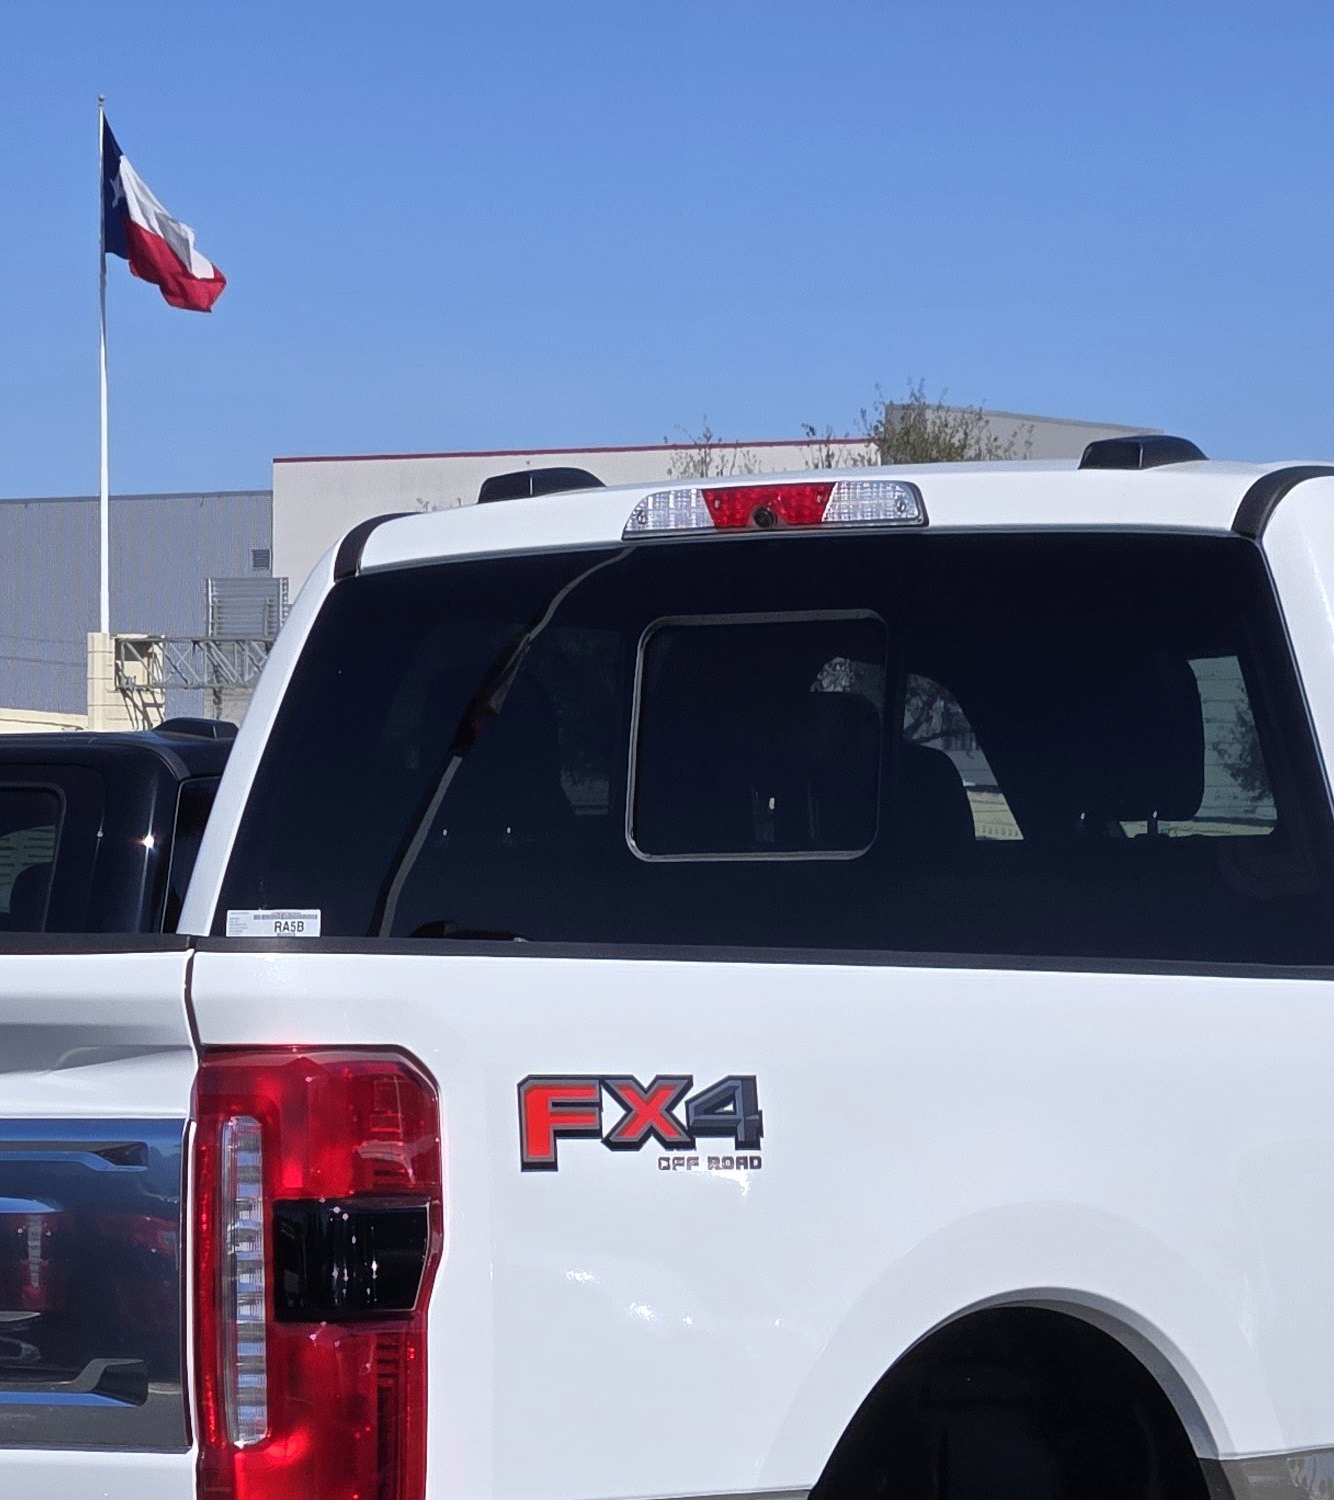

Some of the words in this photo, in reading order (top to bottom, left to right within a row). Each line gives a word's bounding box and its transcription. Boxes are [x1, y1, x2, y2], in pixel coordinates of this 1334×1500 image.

[517, 1074, 763, 1172] FX4
[658, 1156, 700, 1171] OFF
[707, 1155, 763, 1171] ROAD
